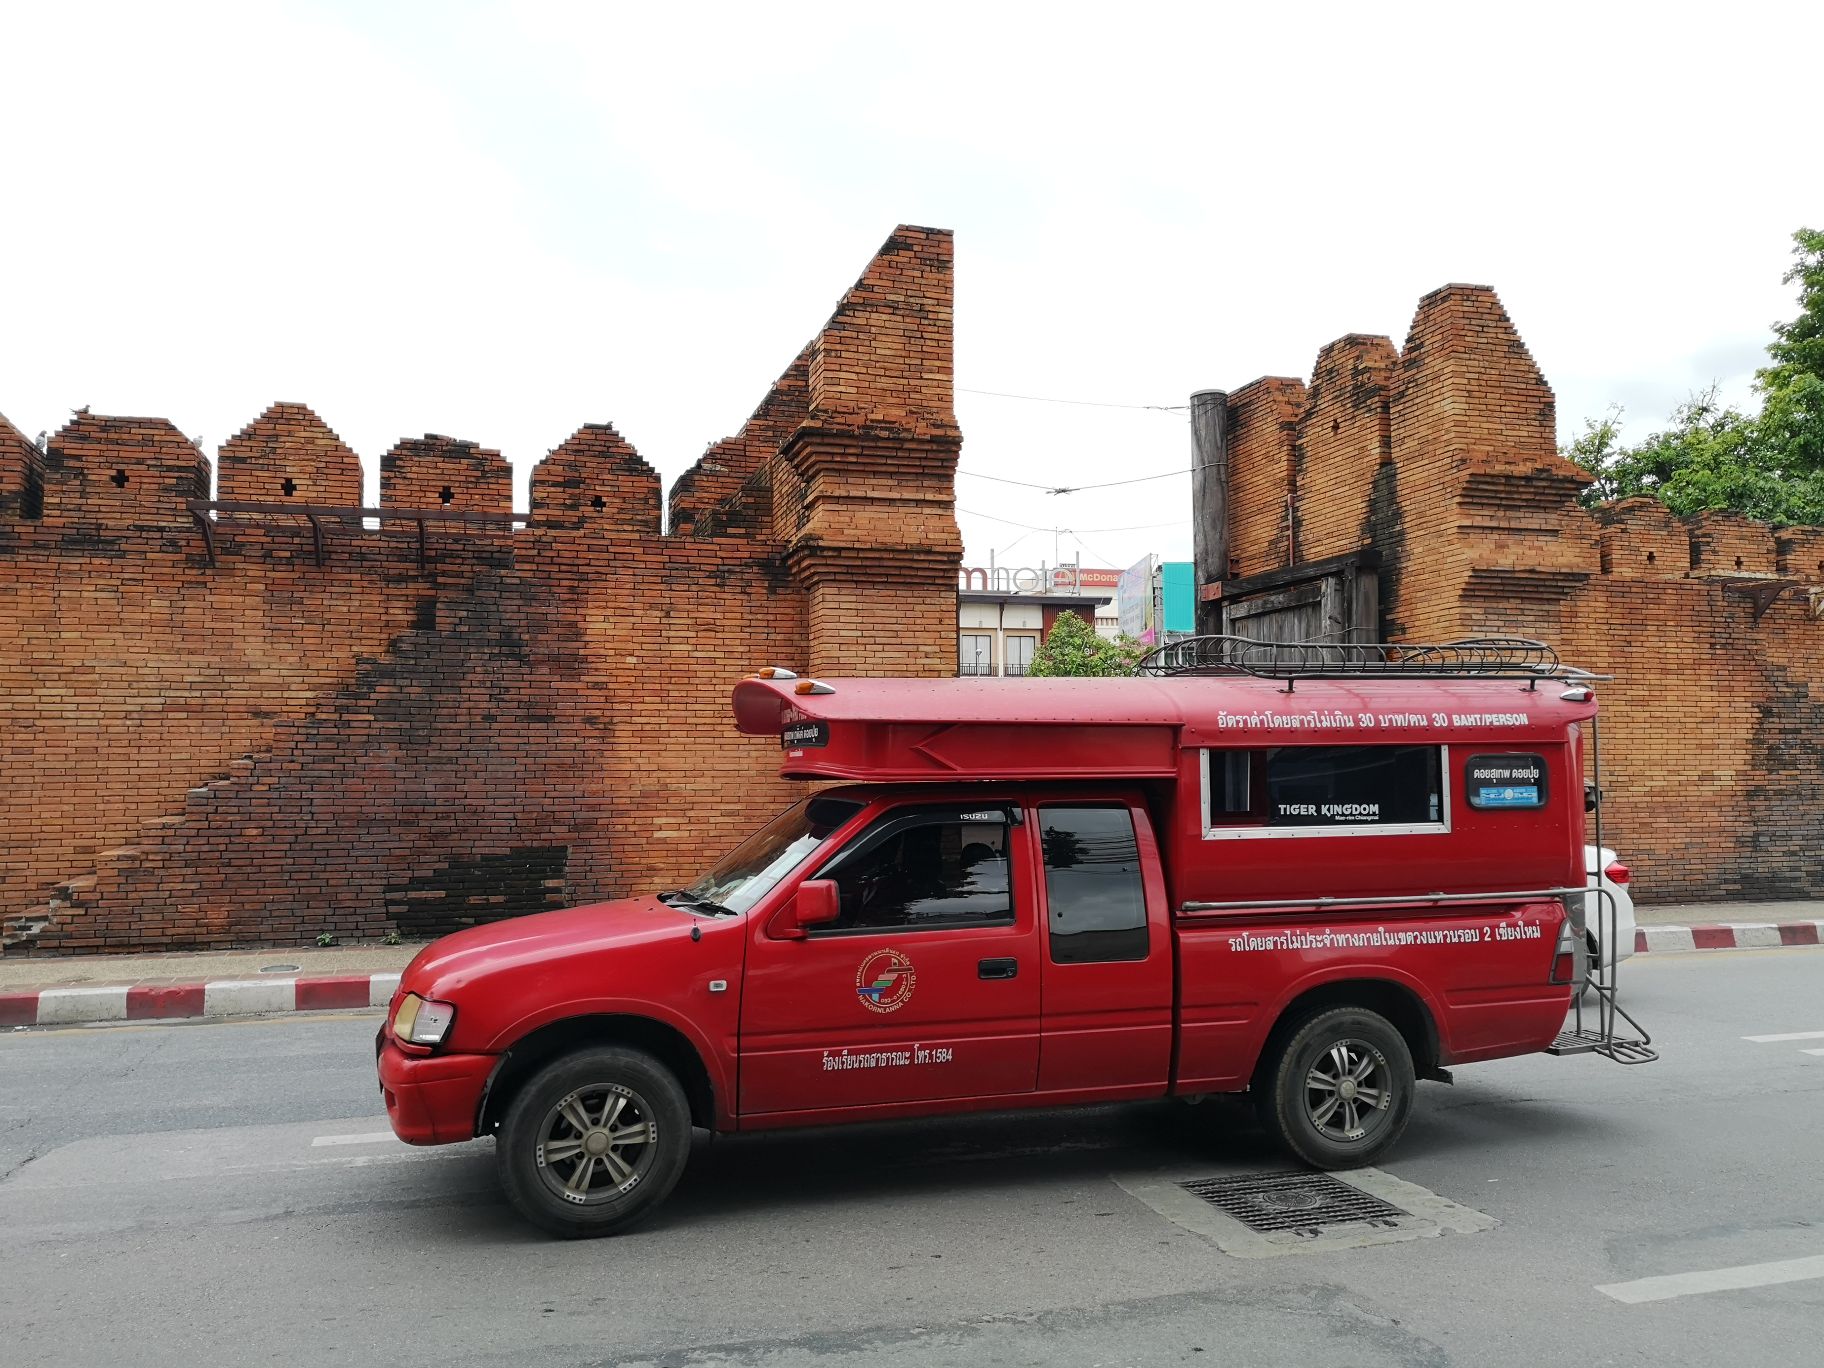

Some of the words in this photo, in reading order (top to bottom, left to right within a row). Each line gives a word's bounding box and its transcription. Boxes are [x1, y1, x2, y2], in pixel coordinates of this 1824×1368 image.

[1079, 573, 1118, 583] McDona
[1217, 710, 1354, 728] อัตราค่าโดยสารไม่เกิน
[1359, 713, 1375, 727] 30
[1379, 713, 1428, 727] บาท/คน
[1432, 713, 1448, 727] 30
[1452, 713, 1529, 726] BAHT/PERSON
[1473, 768, 1511, 784] ดอยสุเทพ
[1511, 765, 1539, 783] ดอยปุย
[1278, 803, 1317, 816] TIGER
[1321, 803, 1379, 817] KINGDOM
[1483, 926, 1491, 941] 2
[1495, 920, 1541, 940] เชียงใหม่
[858, 995, 904, 1014] NAKORNLANNA
[822, 1050, 911, 1071] ร้องเรียนรถสาธารณะ
[913, 1043, 953, 1065] โทร.1584
